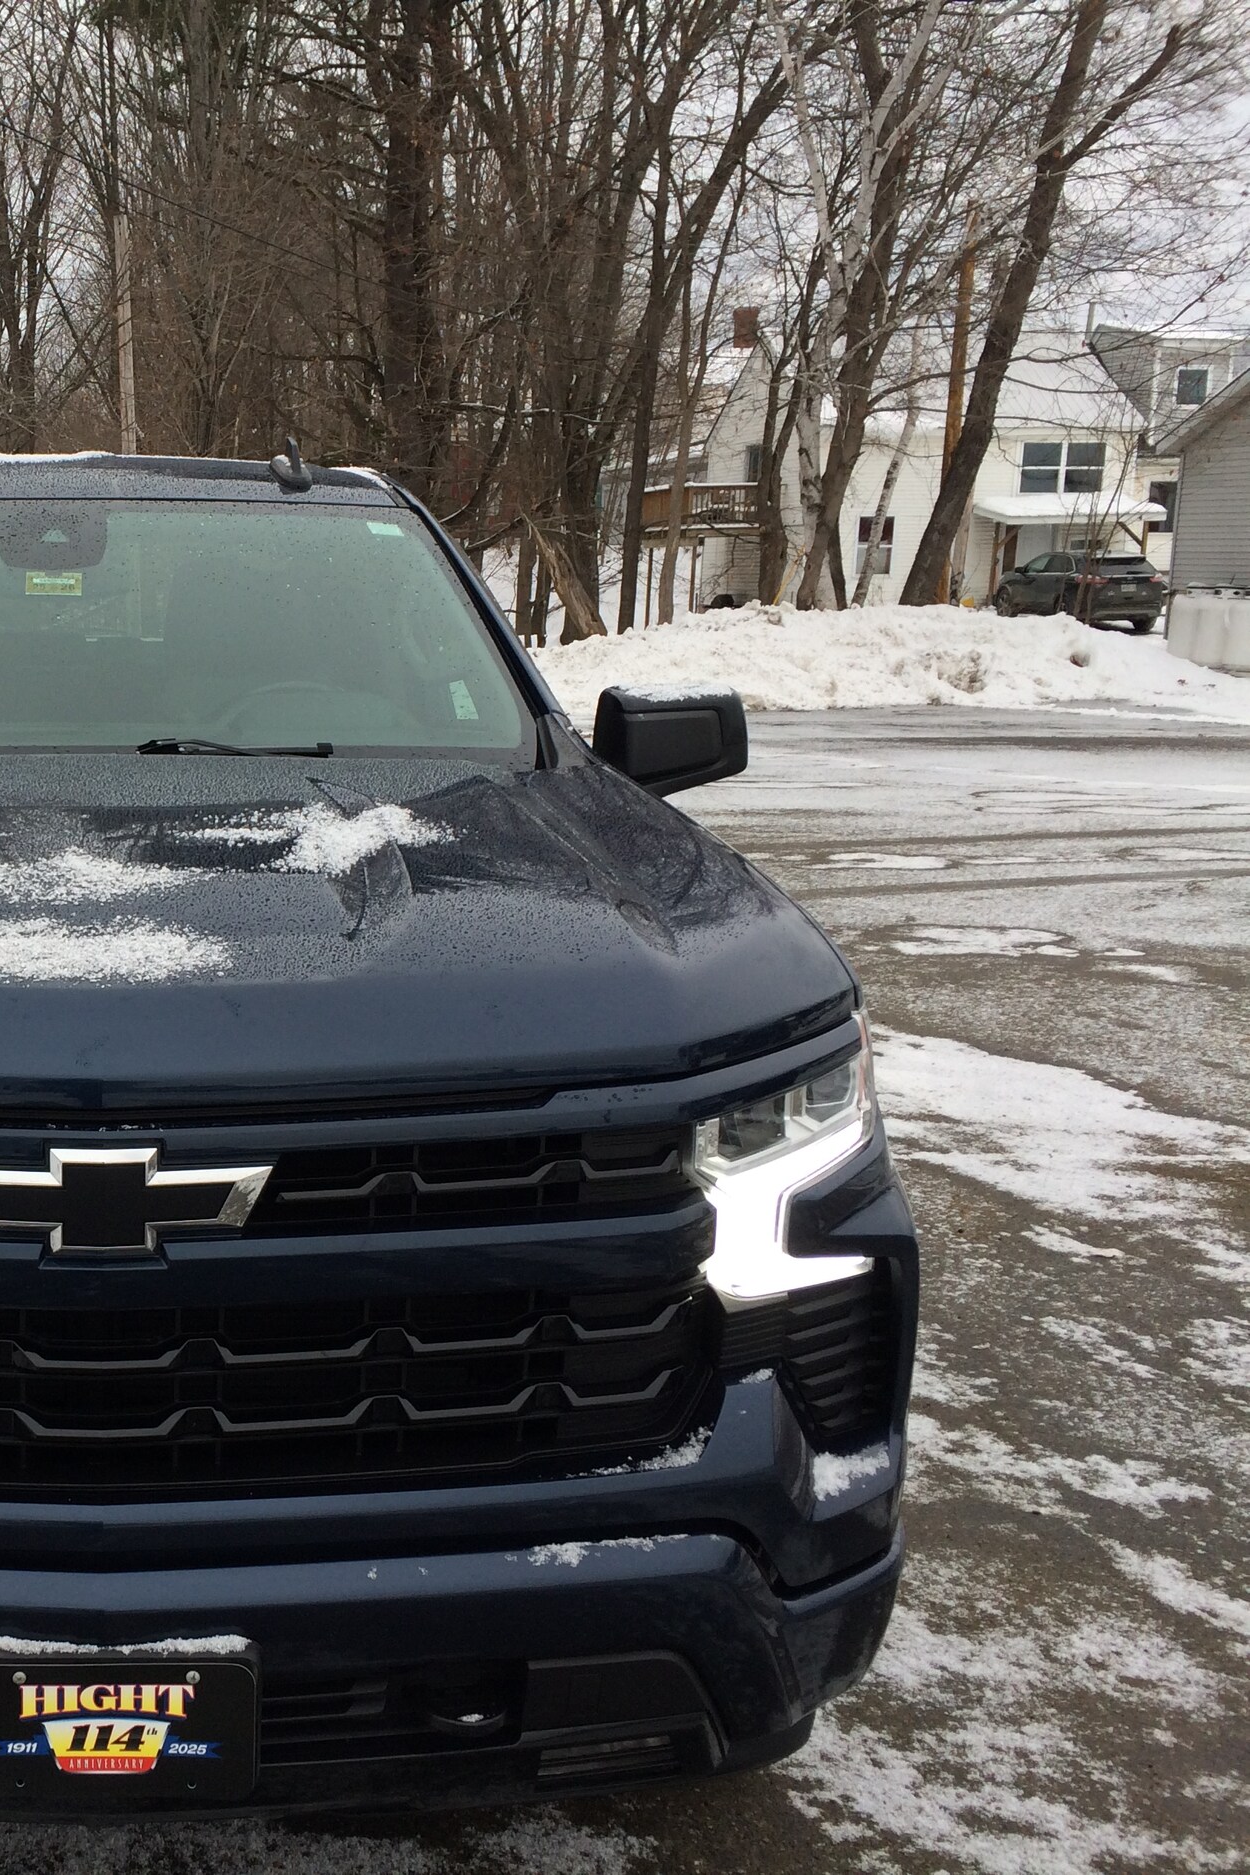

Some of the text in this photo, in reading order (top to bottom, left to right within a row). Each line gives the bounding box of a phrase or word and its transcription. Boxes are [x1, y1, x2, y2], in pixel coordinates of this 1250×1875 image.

[19, 1684, 195, 1719] HIGHT
[7, 1743, 38, 1754] 1911
[168, 1743, 208, 1755] 2025
[69, 1758, 145, 1769] ANNIVERSARY
